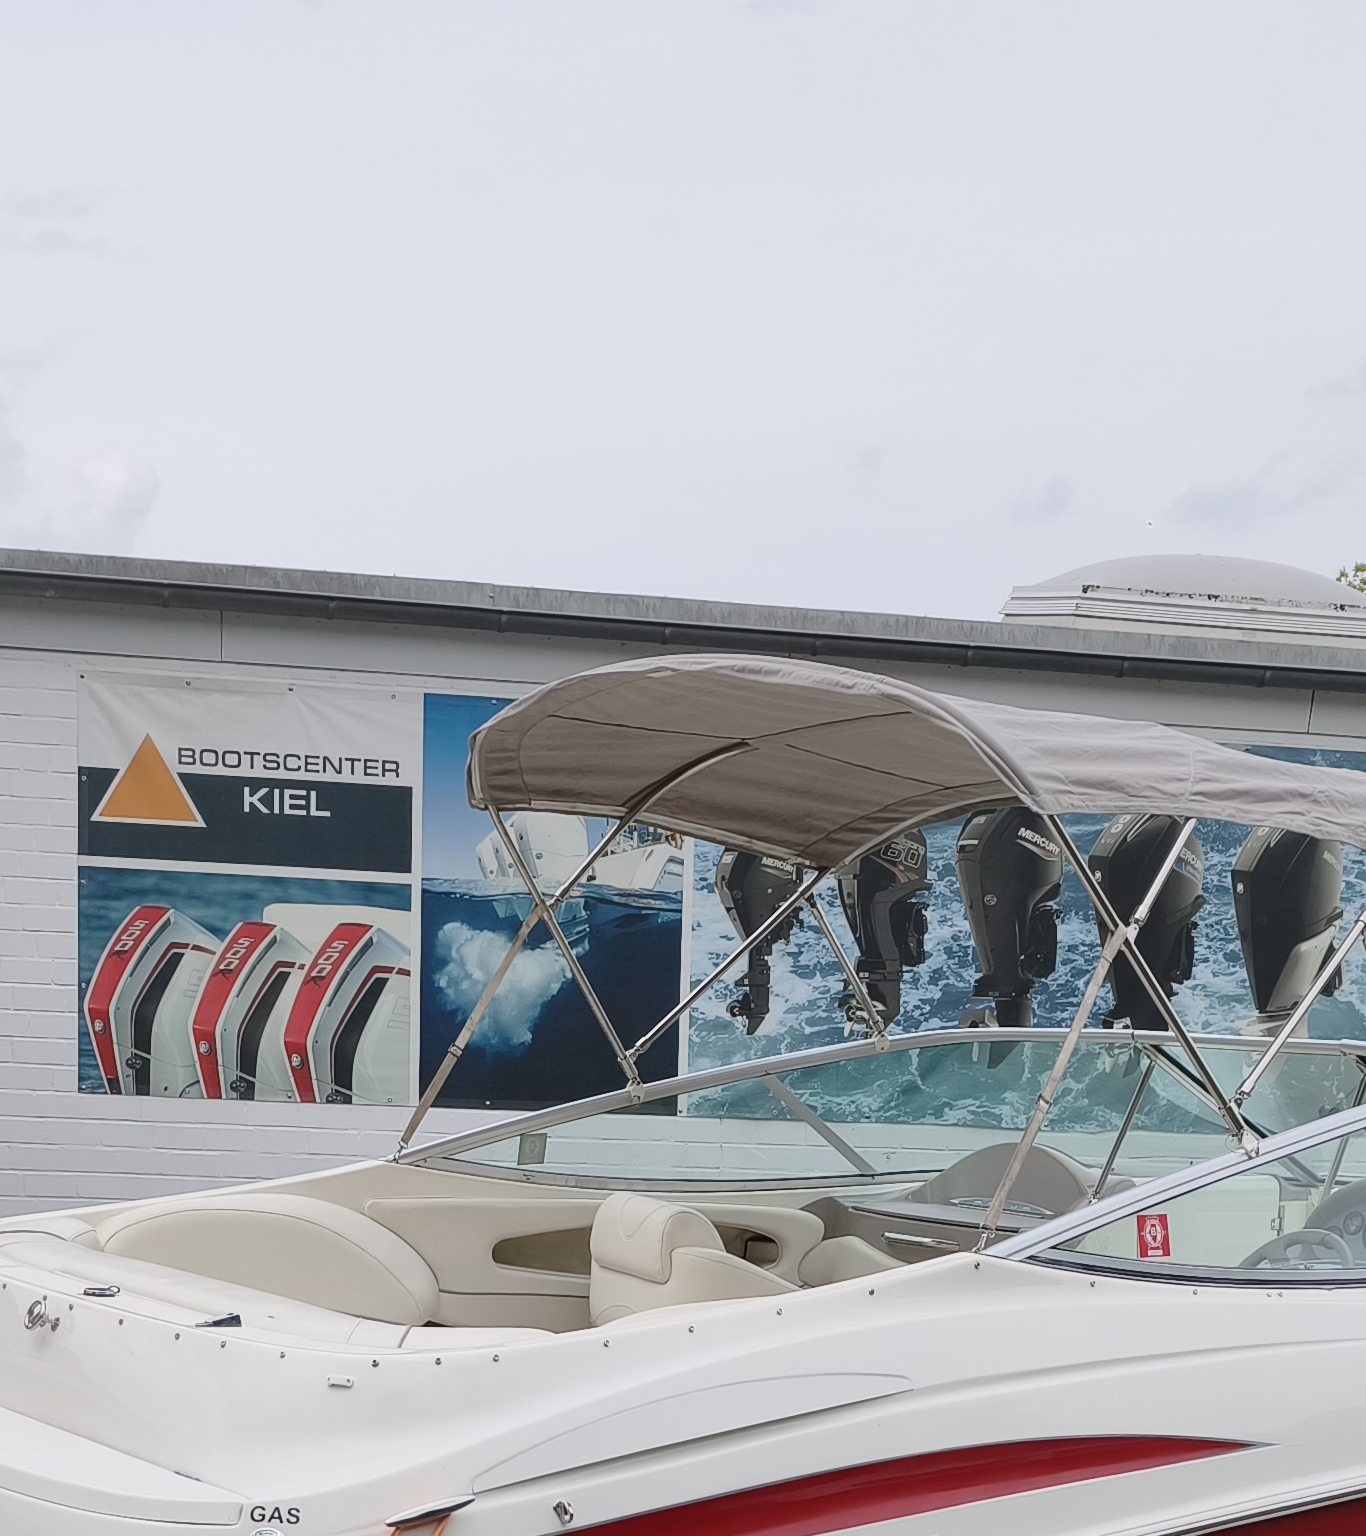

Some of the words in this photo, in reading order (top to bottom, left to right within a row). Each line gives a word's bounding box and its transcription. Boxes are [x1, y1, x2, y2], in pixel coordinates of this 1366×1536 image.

[177, 747, 401, 779] BOOTSCENTER
[242, 786, 332, 818] KIEL
[1017, 827, 1061, 856] MERCURY
[1179, 846, 1204, 871] ERCUR
[250, 1505, 301, 1525] GAS
